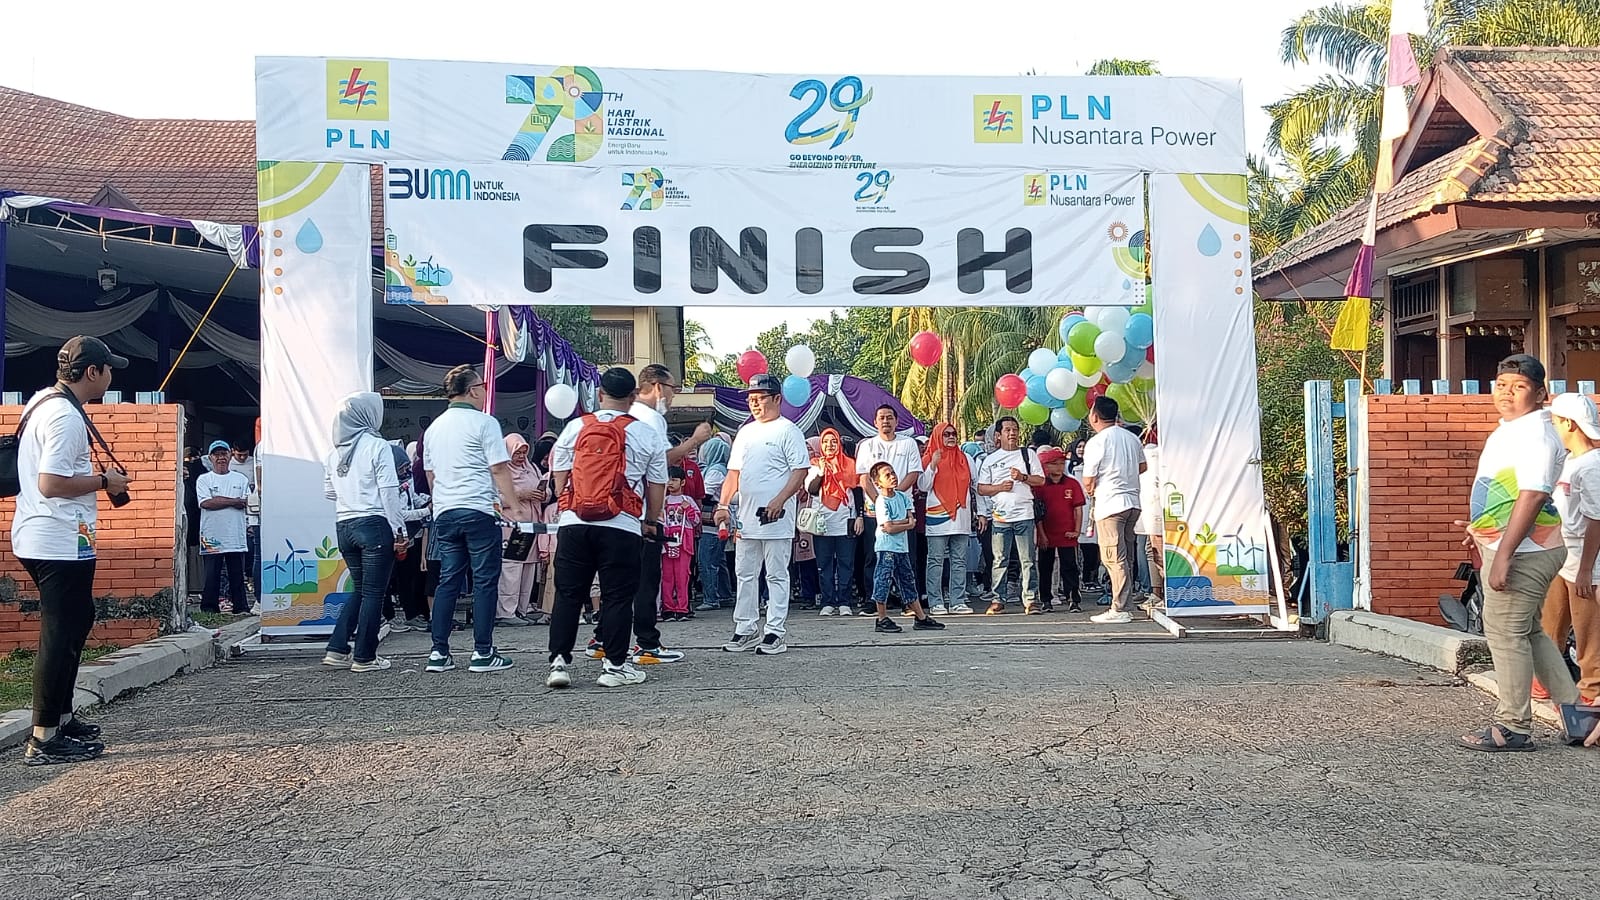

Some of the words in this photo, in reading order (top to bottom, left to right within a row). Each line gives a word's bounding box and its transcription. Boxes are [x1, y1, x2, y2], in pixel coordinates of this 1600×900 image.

[607, 109, 636, 118] HARI
[785, 75, 874, 150] 29
[1032, 95, 1112, 121] PLN
[607, 118, 652, 127] LISTRIK
[326, 128, 390, 149] PLN
[607, 127, 665, 137] NASIONAL
[1032, 125, 1144, 145] Nusantara
[1151, 127, 1217, 146] Power
[789, 161, 833, 169] ENERGIZING
[473, 181, 505, 191] UNTUK
[854, 170, 895, 205] 29
[1050, 174, 1088, 191] PLN
[473, 191, 521, 201] INDONESIA
[1050, 194, 1102, 206] Nusantara
[1104, 194, 1136, 206] Power
[523, 224, 1033, 295] FINISH
